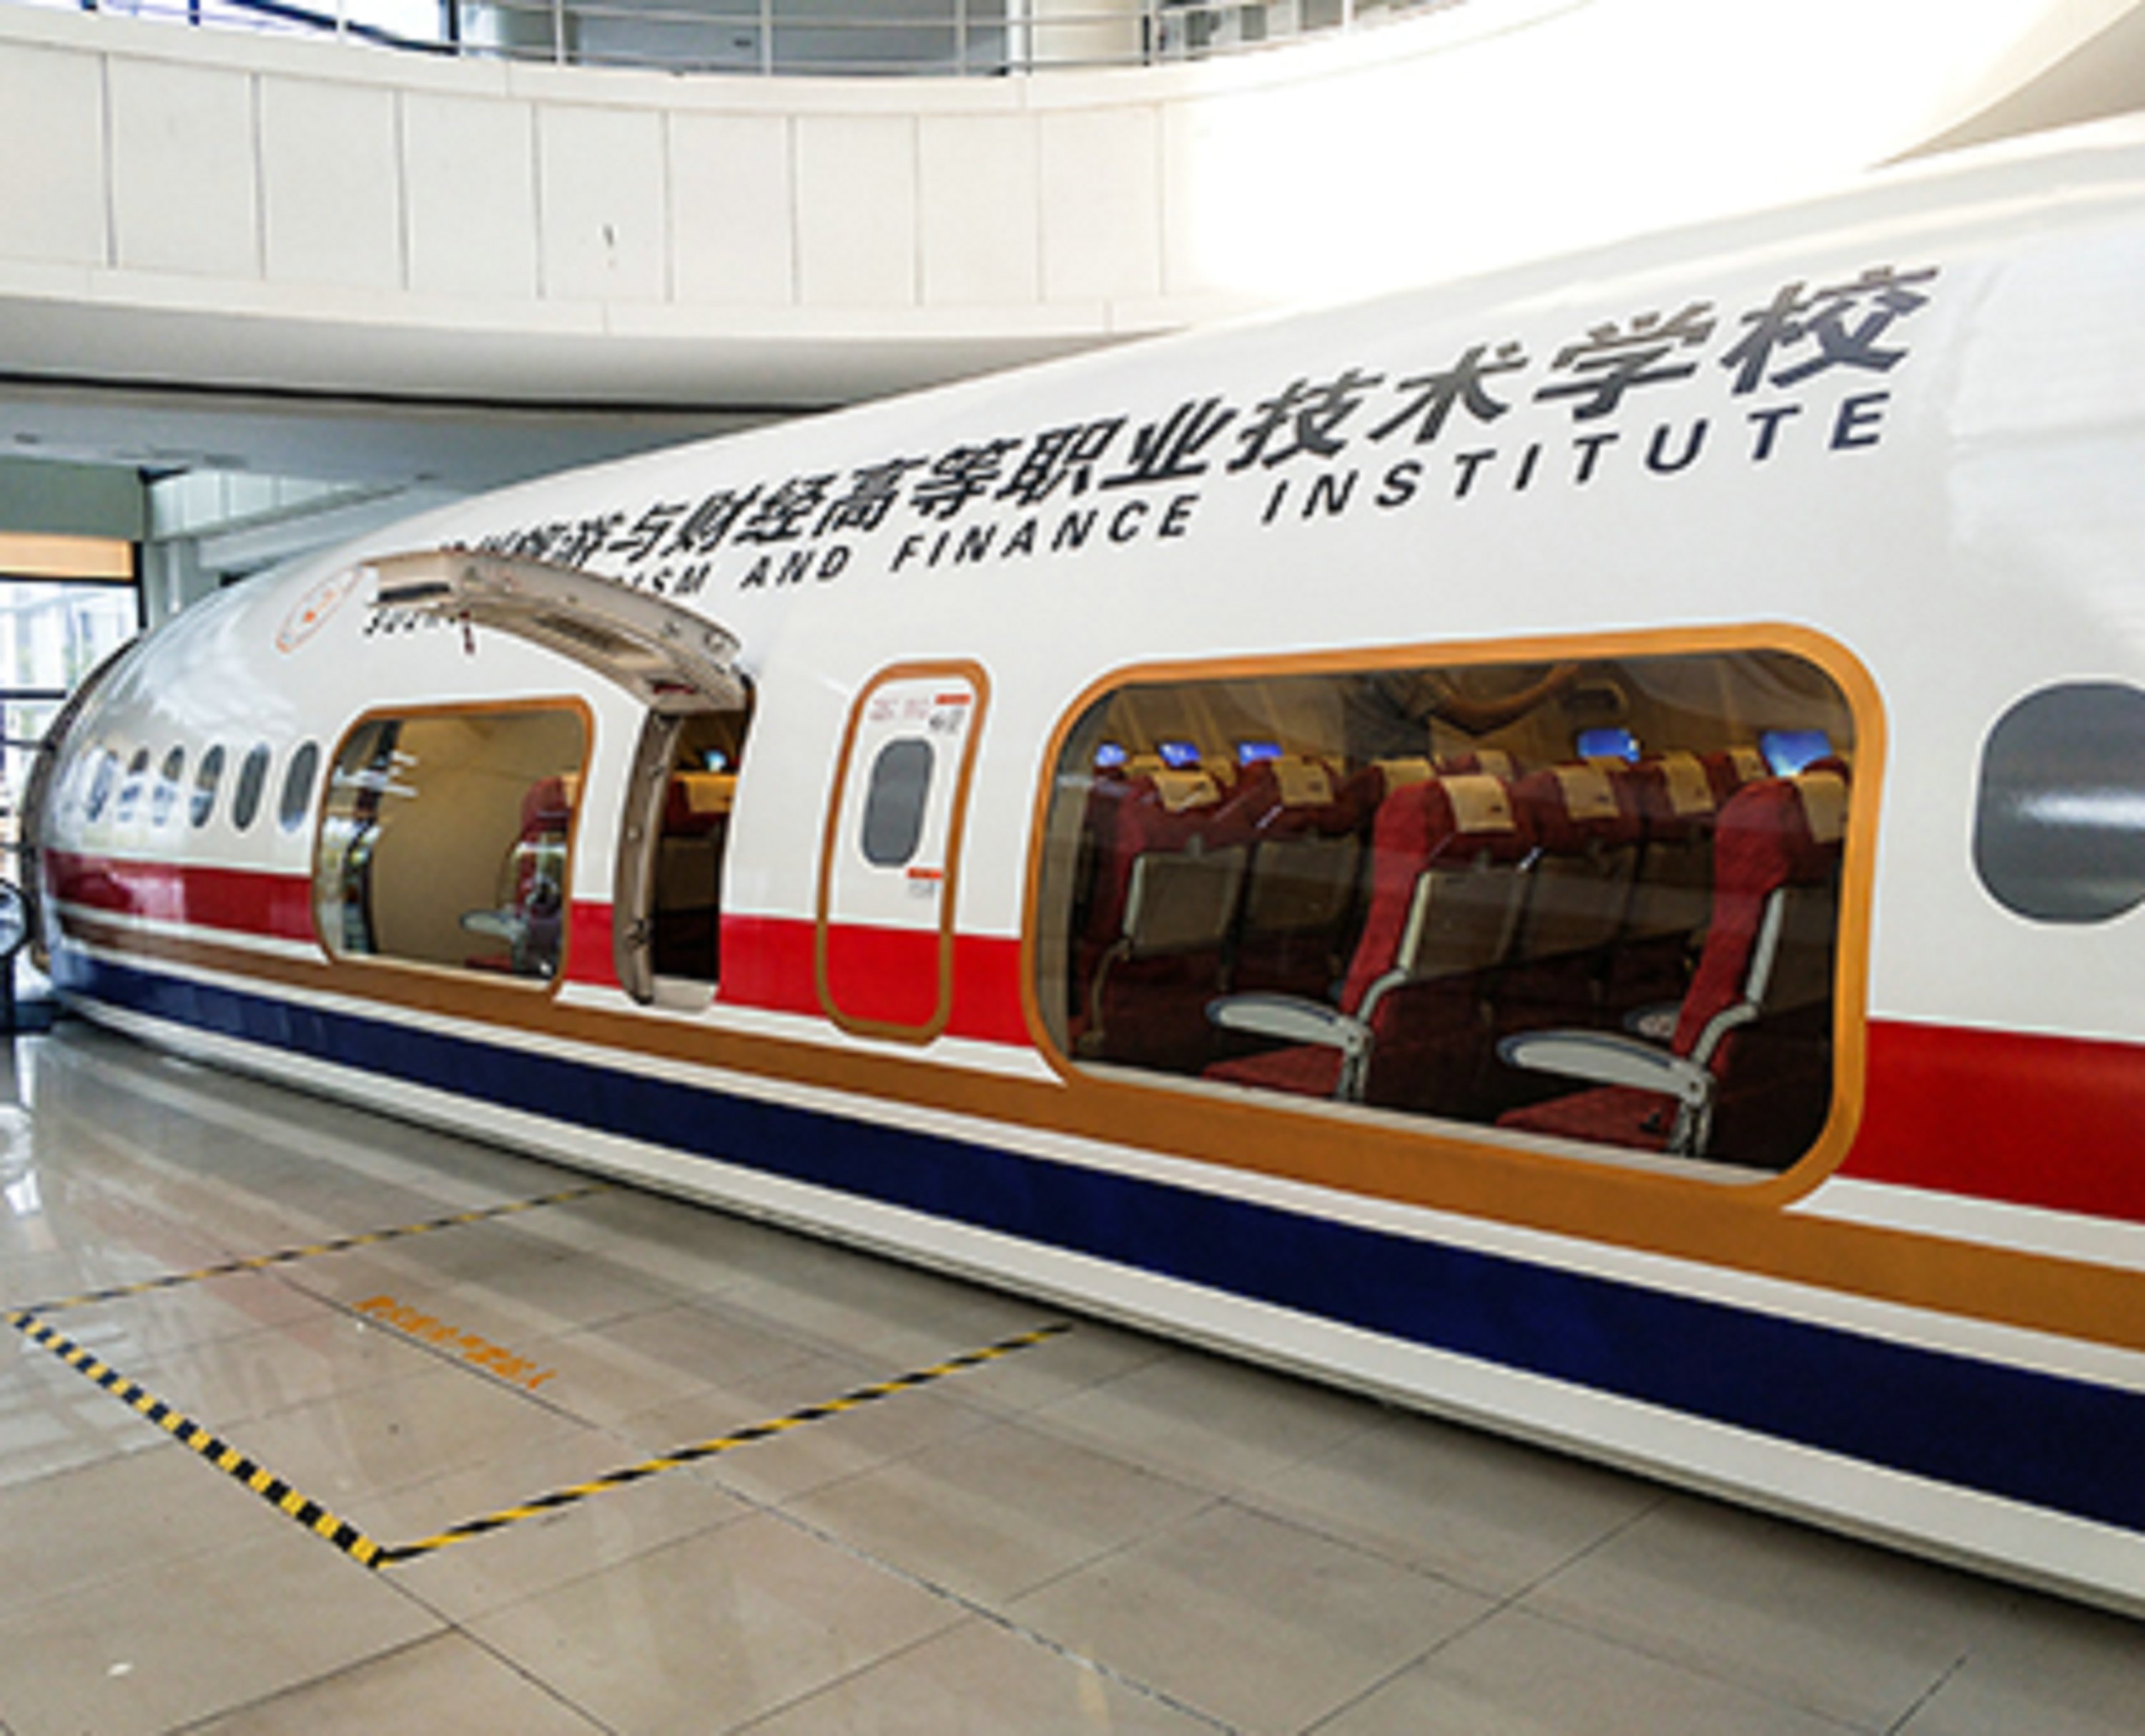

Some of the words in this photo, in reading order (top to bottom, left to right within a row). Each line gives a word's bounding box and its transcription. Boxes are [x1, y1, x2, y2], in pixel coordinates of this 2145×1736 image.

[739, 545, 851, 588] AND
[890, 494, 1200, 571] FINANCE
[1262, 392, 1890, 524] INSTITUTE
